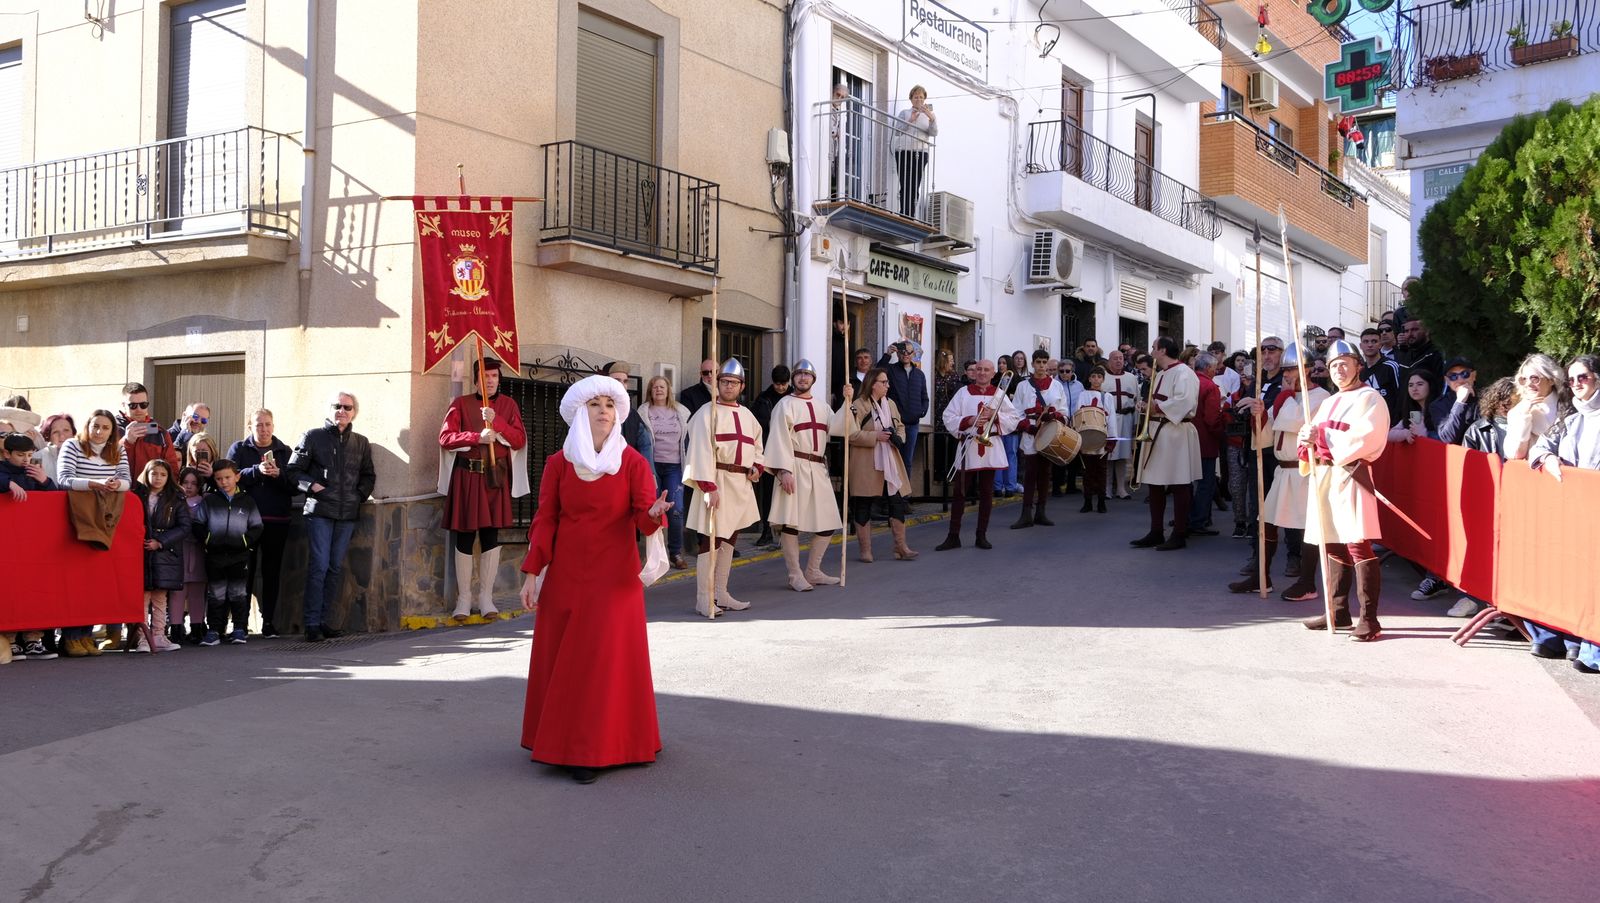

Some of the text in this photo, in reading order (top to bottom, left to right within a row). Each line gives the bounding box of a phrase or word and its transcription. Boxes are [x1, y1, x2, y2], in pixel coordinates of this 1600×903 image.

[910, 0, 983, 53] Restaurante
[930, 37, 983, 73] Hermanos Castillo
[1438, 166, 1465, 176] CALLE
[869, 258, 957, 295] CAFE-BAR Castillo
